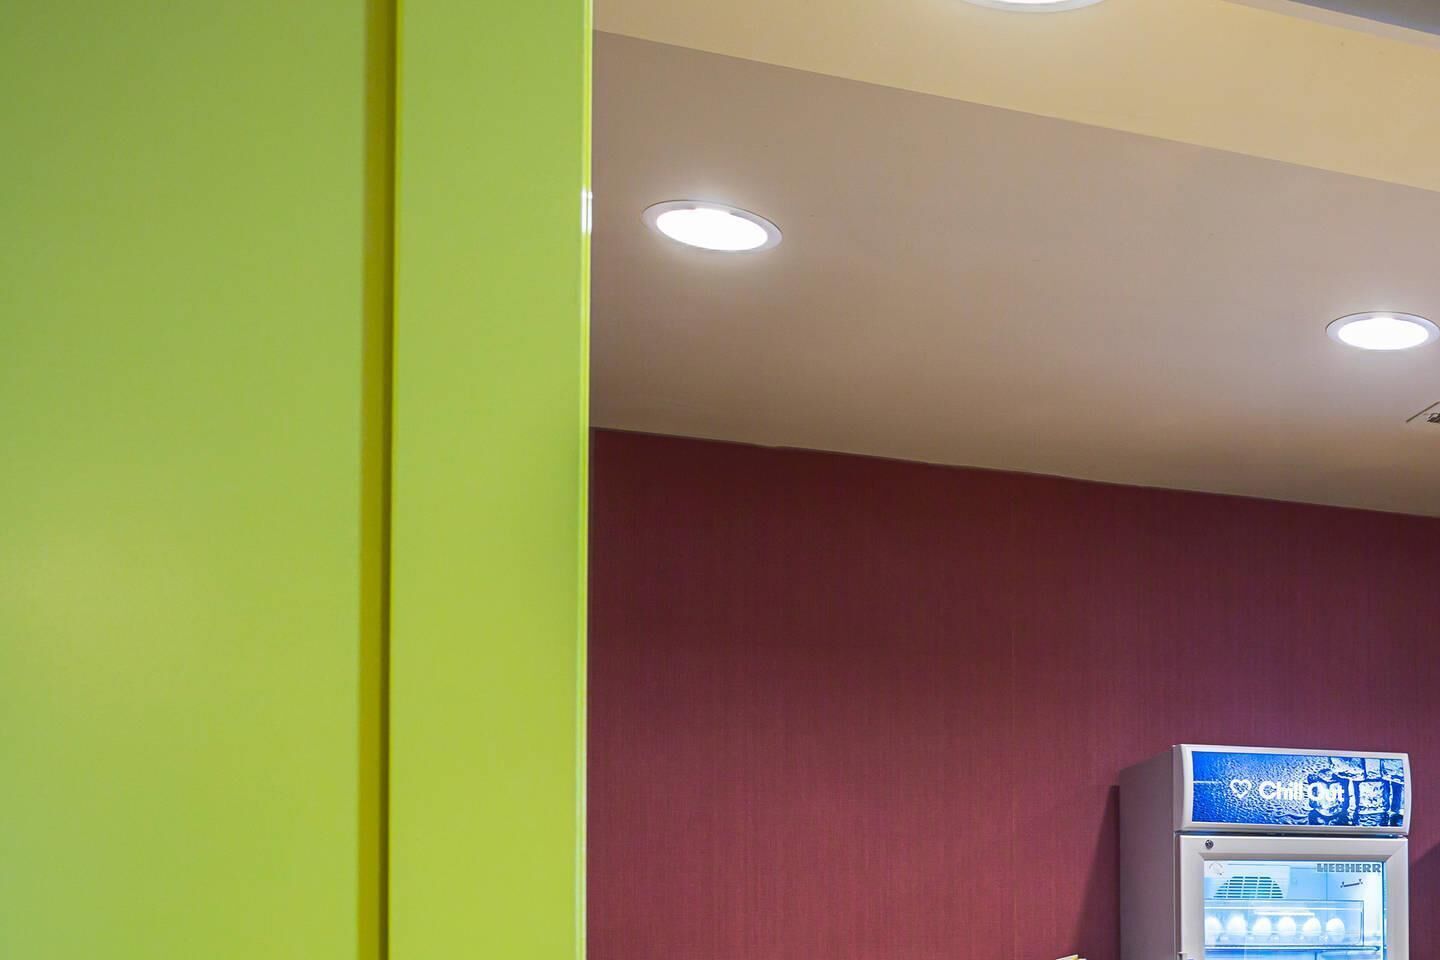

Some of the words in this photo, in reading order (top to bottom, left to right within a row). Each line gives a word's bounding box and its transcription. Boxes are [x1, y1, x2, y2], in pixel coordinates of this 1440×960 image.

[1259, 781, 1303, 800] Chill
[1308, 782, 1344, 801] Out
[1317, 863, 1381, 872] LIEBHERR
